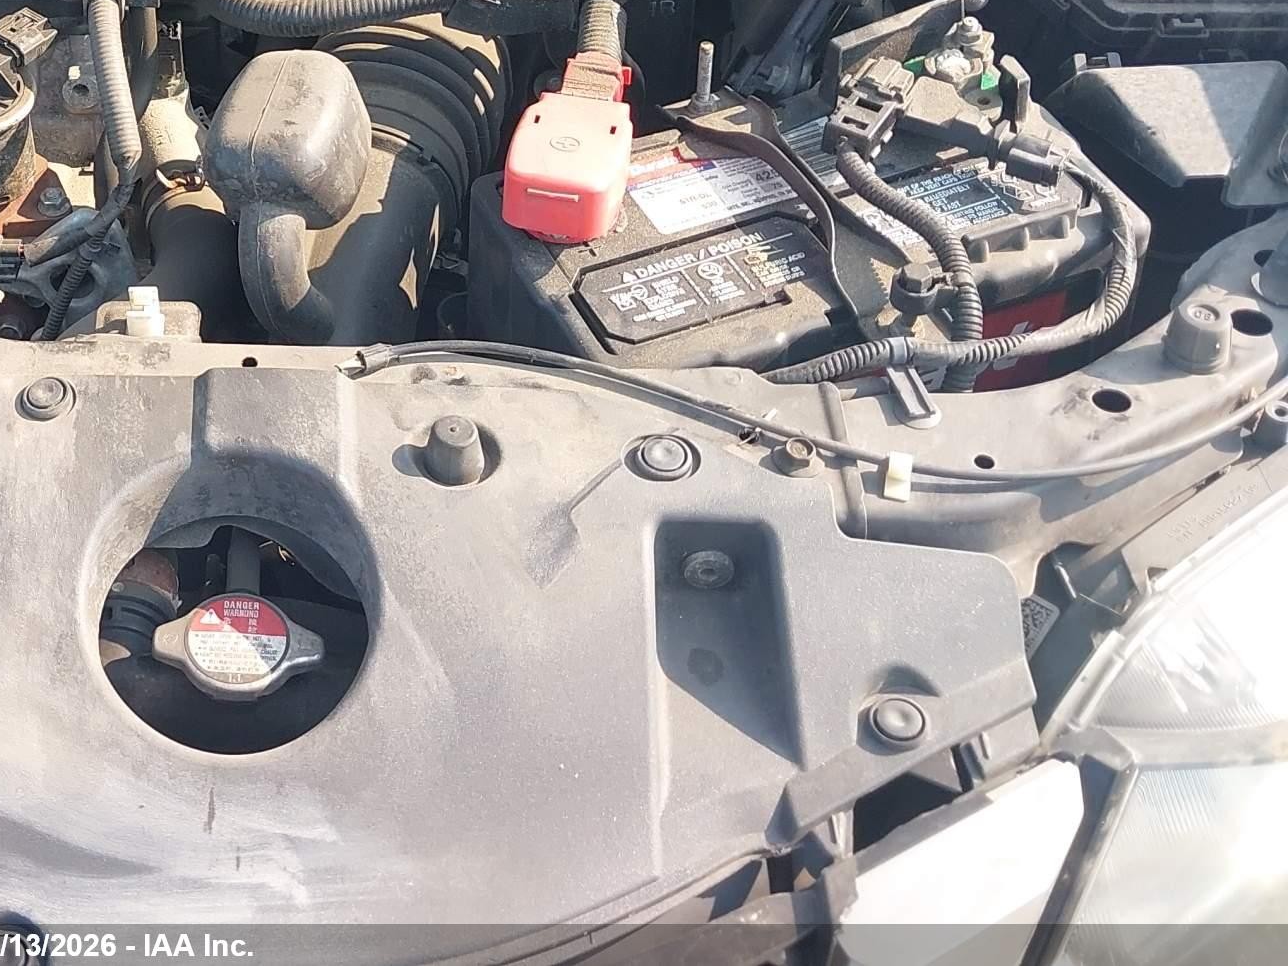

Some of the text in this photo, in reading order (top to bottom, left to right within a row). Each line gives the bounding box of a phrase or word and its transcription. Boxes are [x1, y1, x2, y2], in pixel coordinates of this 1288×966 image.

[635, 253, 698, 279] DANGER
[709, 232, 765, 257] POISON
[223, 600, 260, 610] DANGER
